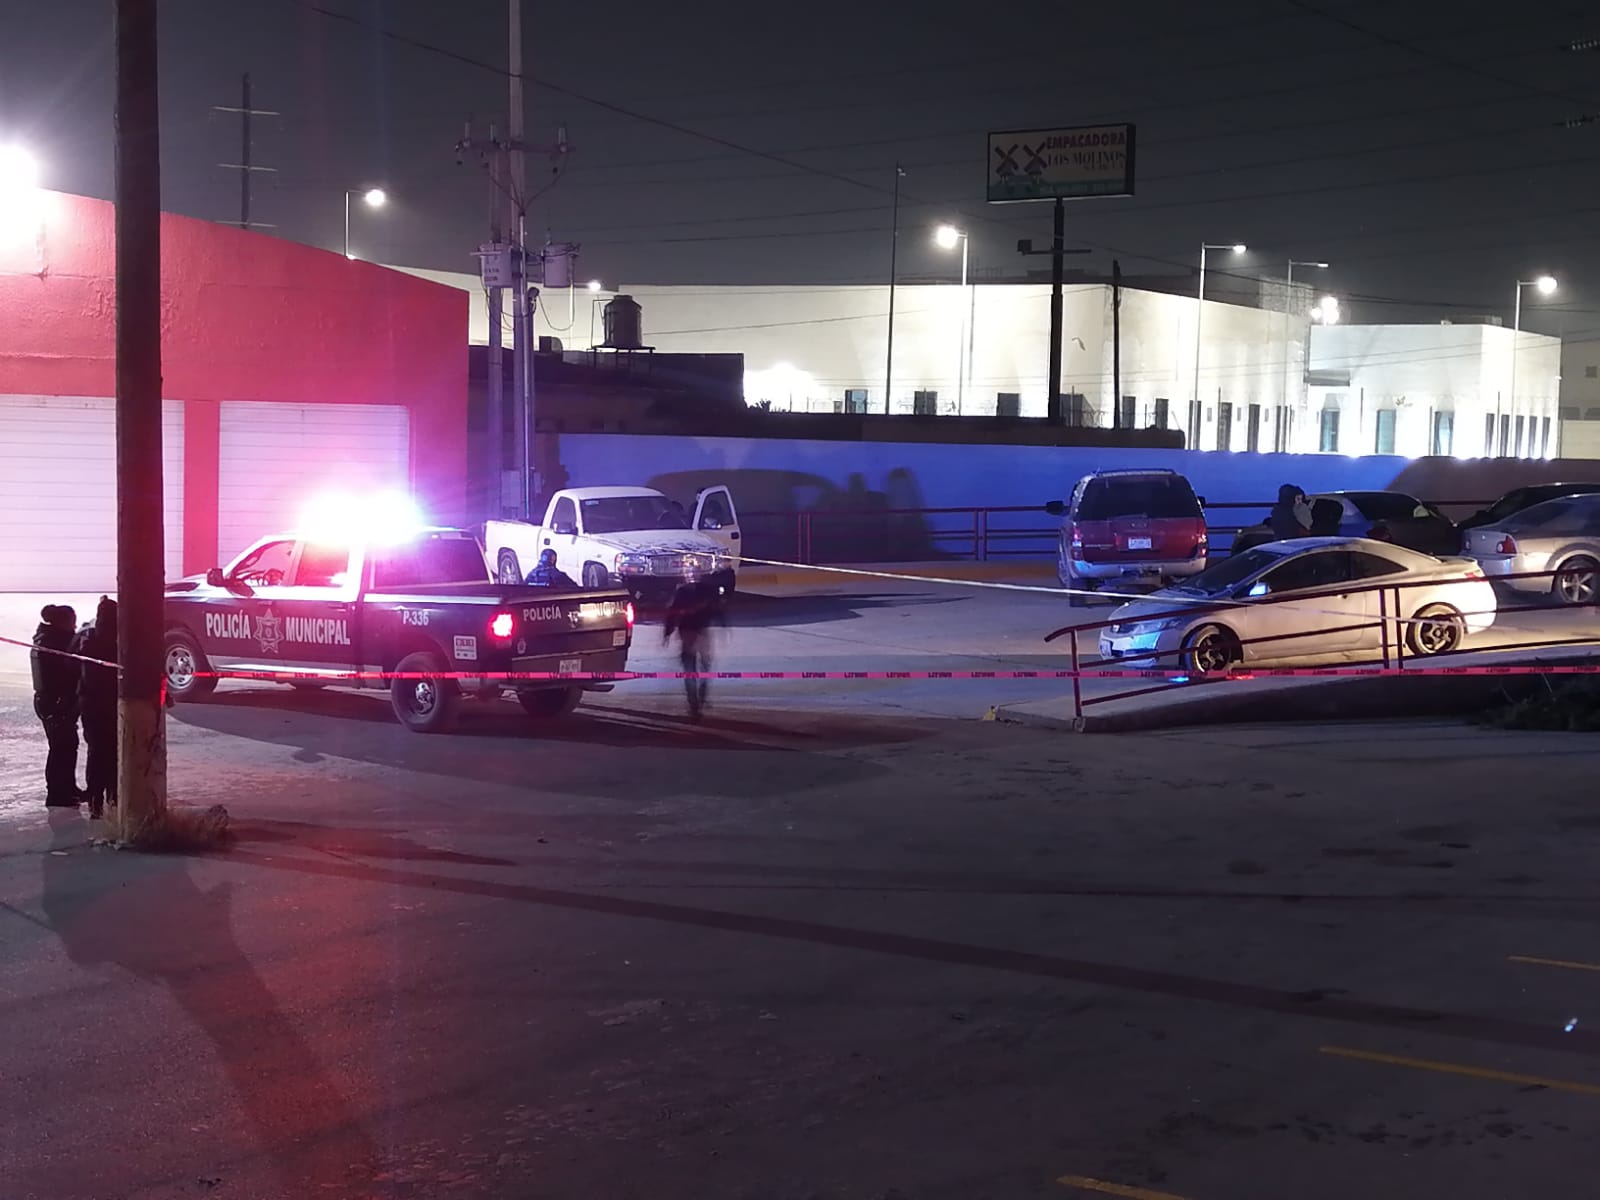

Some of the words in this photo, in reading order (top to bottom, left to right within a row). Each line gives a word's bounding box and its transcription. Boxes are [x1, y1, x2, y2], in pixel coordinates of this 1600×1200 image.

[1046, 132, 1125, 149] EMPACADORA
[1047, 153, 1069, 167] LOS
[1073, 151, 1125, 166] MOLINOS
[403, 611, 429, 625] P-336
[523, 605, 561, 621] POLICÍA
[206, 610, 251, 638] POLICÍA
[286, 617, 350, 645] MUNICIPAL
